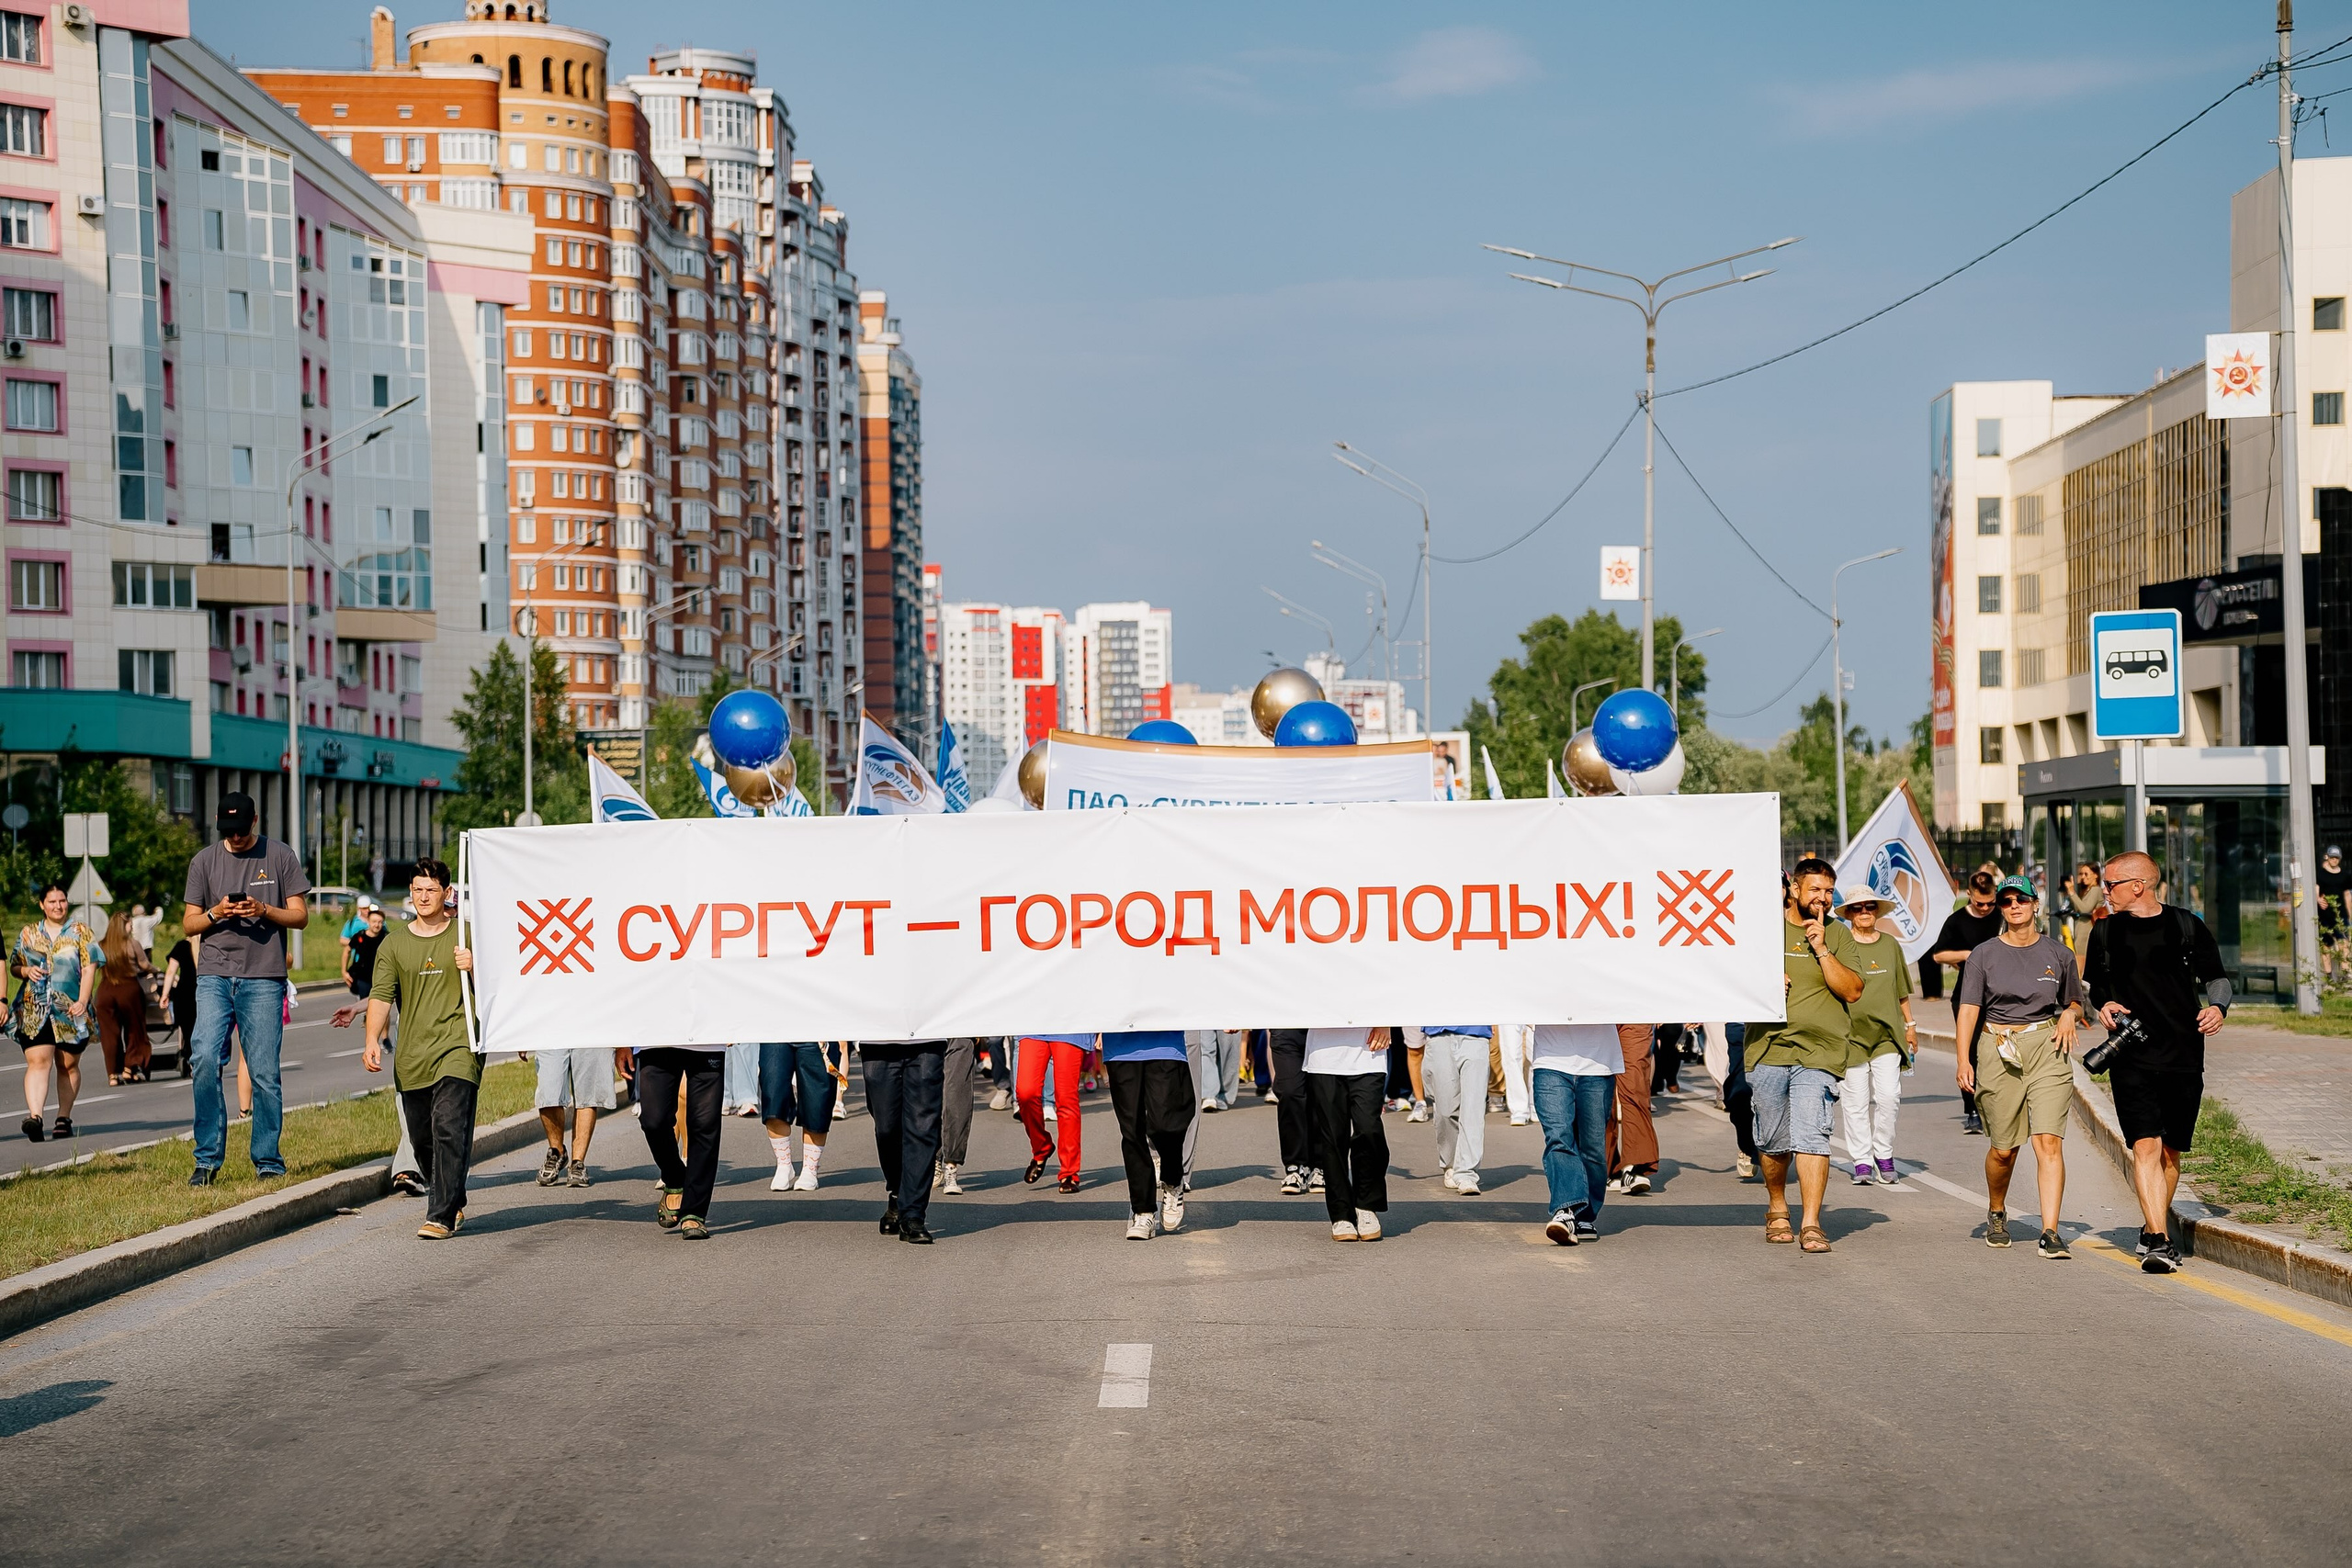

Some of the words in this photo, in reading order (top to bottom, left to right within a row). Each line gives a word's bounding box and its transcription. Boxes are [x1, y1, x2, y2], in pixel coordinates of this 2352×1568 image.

[865, 761, 920, 801] УТНЕФТЕГАЗ
[618, 900, 891, 962] СУРГУТ
[908, 921, 960, 932] —
[980, 890, 1220, 956] ГОРОД
[1239, 882, 1635, 951] МОЛОДЫХ!
